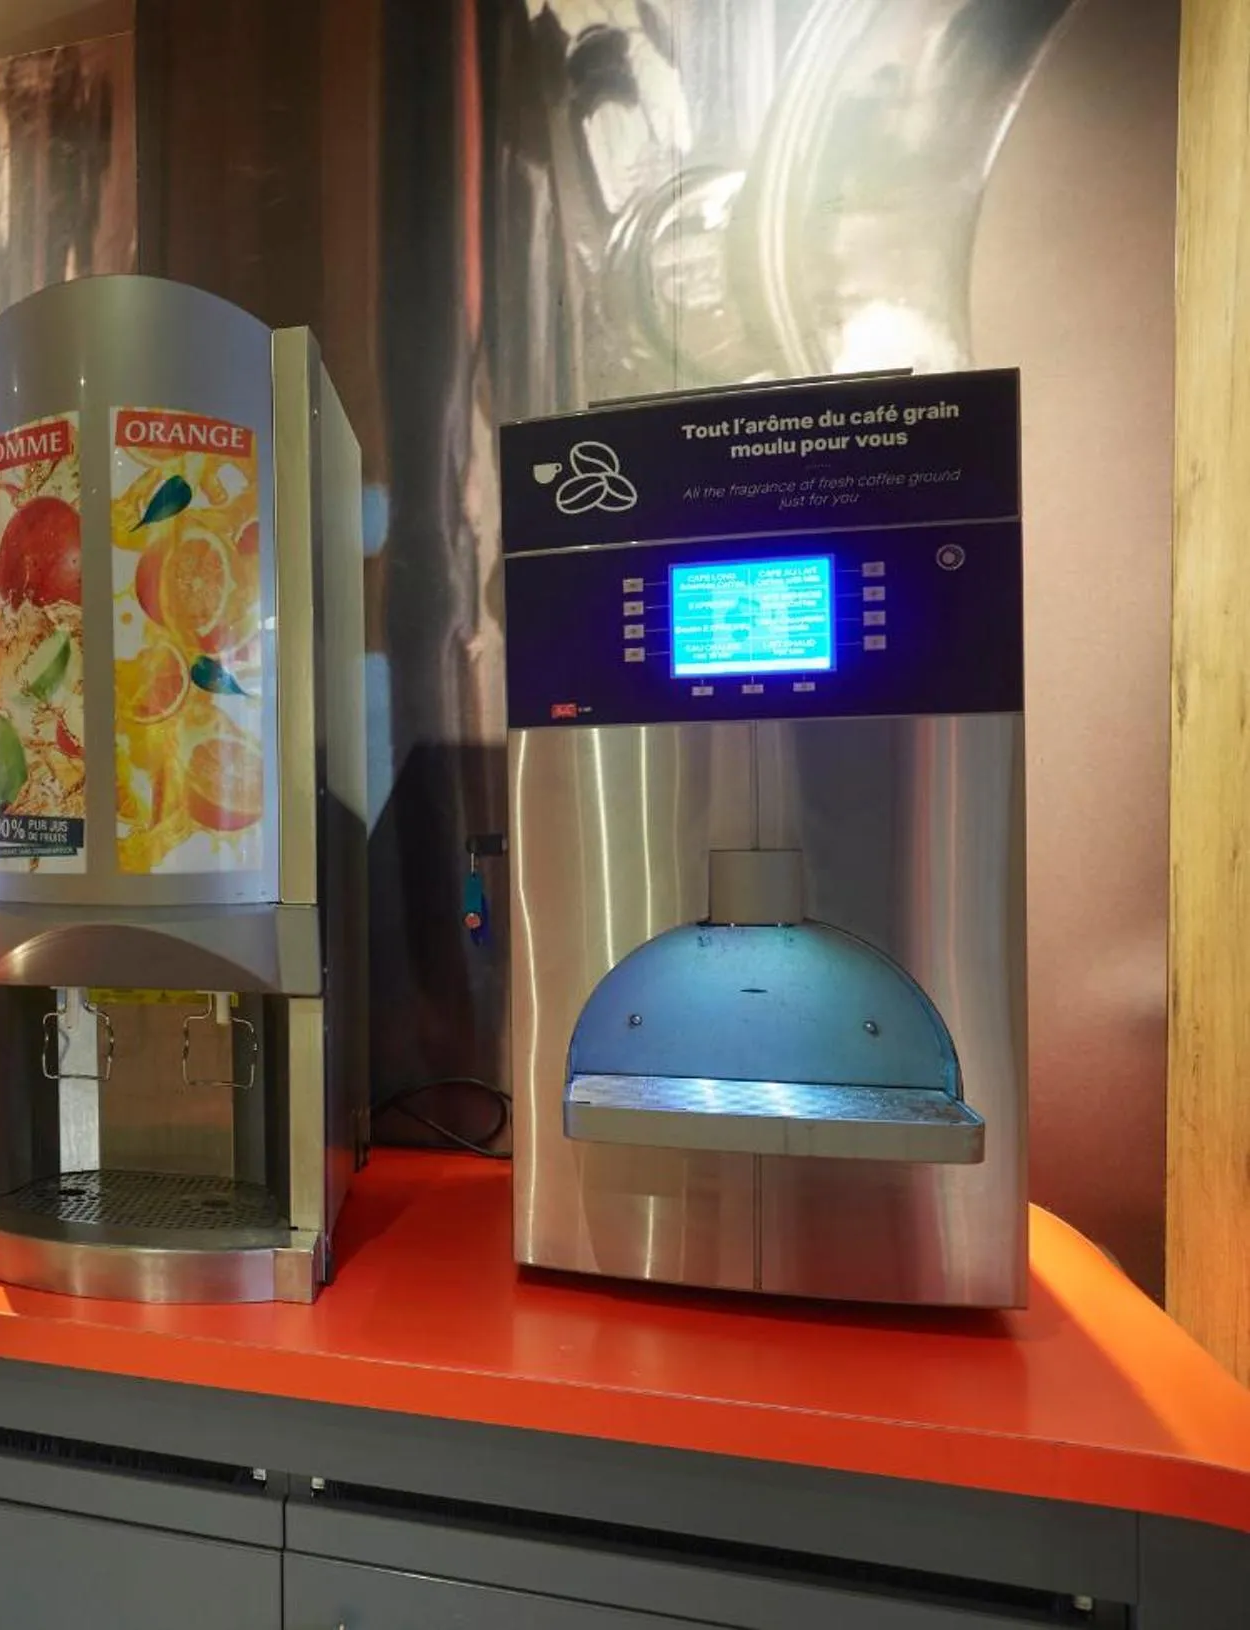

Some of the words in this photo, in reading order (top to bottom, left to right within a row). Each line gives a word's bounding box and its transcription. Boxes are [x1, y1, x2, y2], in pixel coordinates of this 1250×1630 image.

[124, 419, 245, 448] ORANGE
[681, 420, 730, 440] Tout
[733, 414, 814, 435] l'arôme
[818, 409, 846, 428] du
[849, 404, 898, 424] café
[902, 402, 960, 425] grain
[730, 437, 797, 458] moulu
[800, 434, 850, 457] pour
[854, 430, 909, 448] vous
[683, 485, 701, 501] All
[703, 483, 726, 498] the
[729, 478, 797, 499] fragrance
[800, 477, 818, 491] of
[818, 474, 855, 490] fresh
[857, 471, 906, 488] coffee
[908, 468, 962, 488] ground
[778, 495, 805, 511] just
[808, 492, 830, 506] for
[831, 492, 861, 508] you
[27, 832, 38, 841] DE
[40, 832, 69, 843] FRUITS
[28, 819, 48, 832] PUR
[49, 820, 69, 833] JUS
